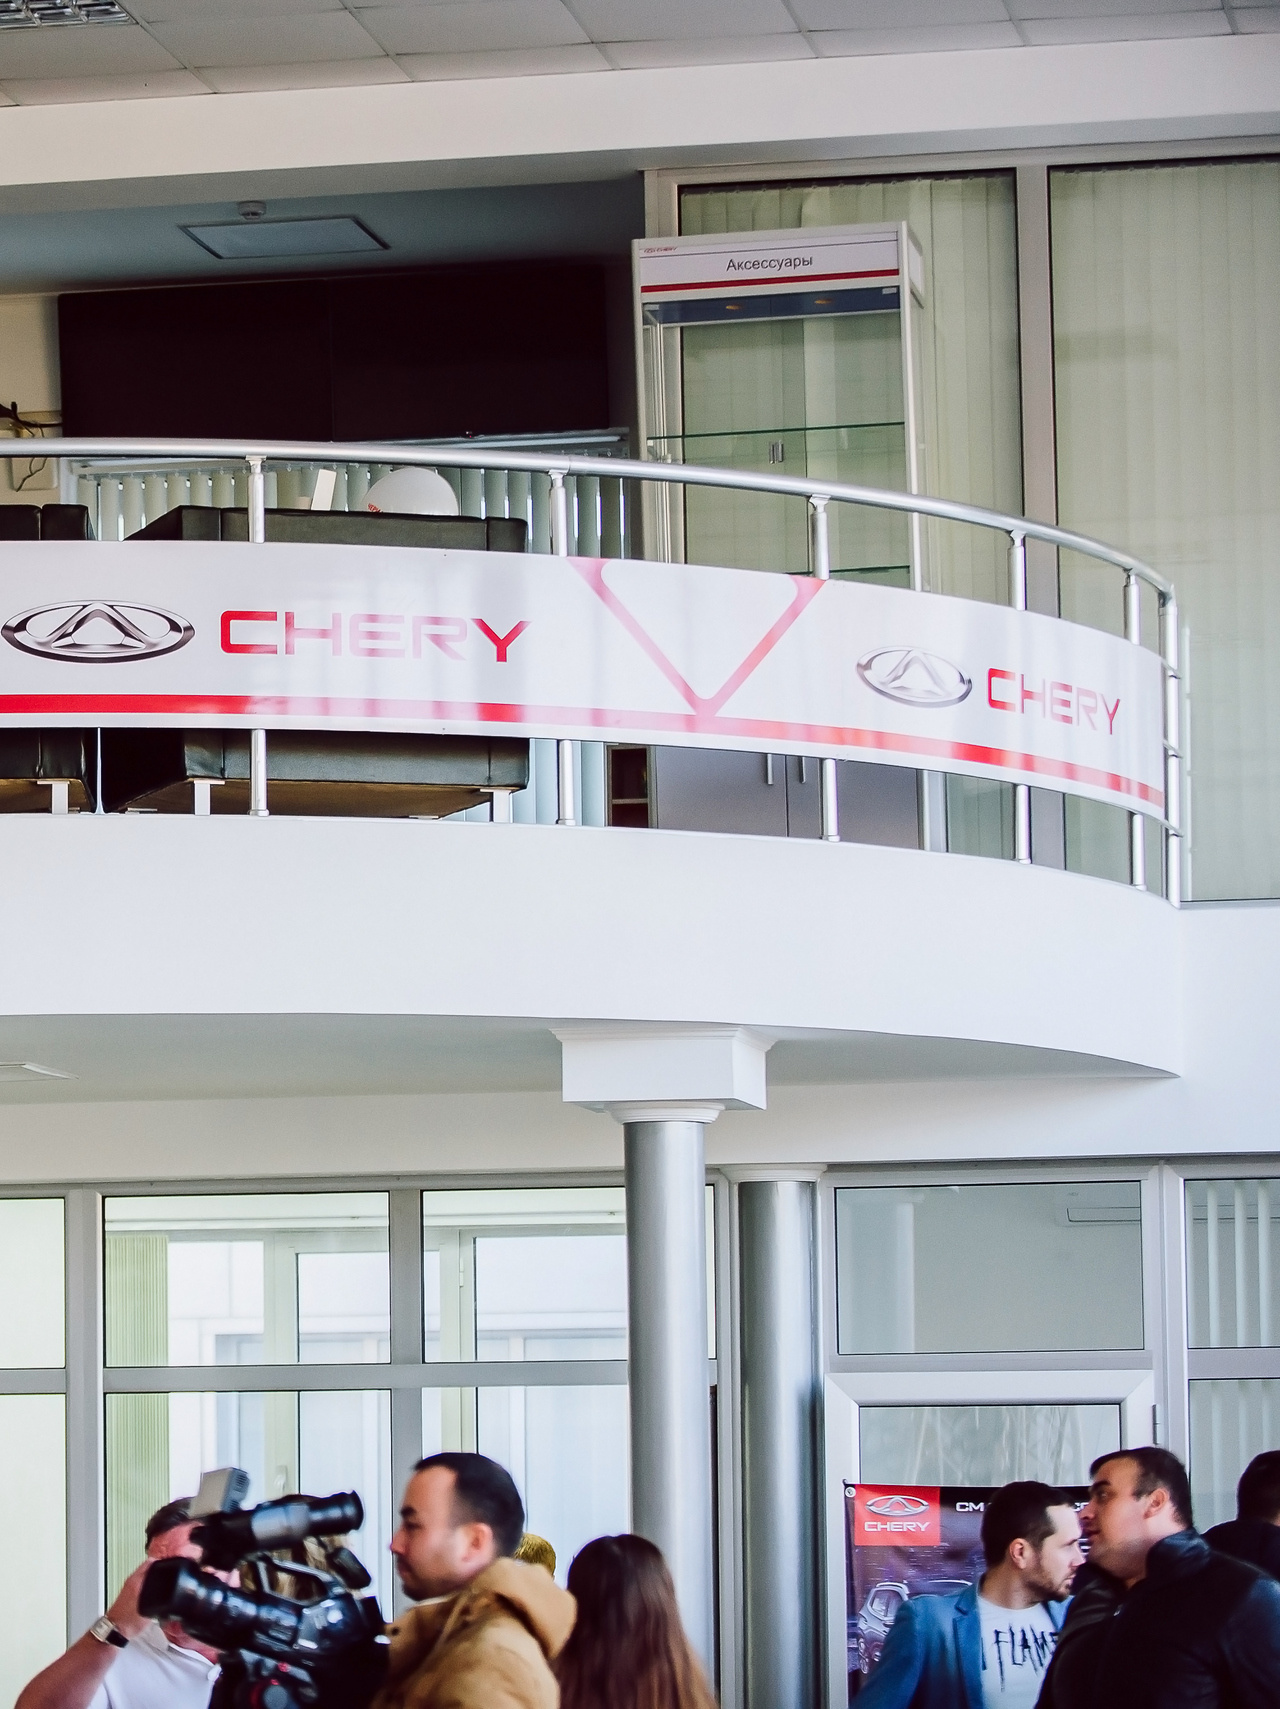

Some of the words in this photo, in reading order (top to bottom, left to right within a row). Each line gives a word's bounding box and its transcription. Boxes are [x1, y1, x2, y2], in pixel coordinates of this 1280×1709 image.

[726, 256, 813, 271] Аксессуары
[220, 610, 532, 663] CHERY
[987, 667, 1120, 735] CHERY
[864, 1521, 931, 1532] CHERY
